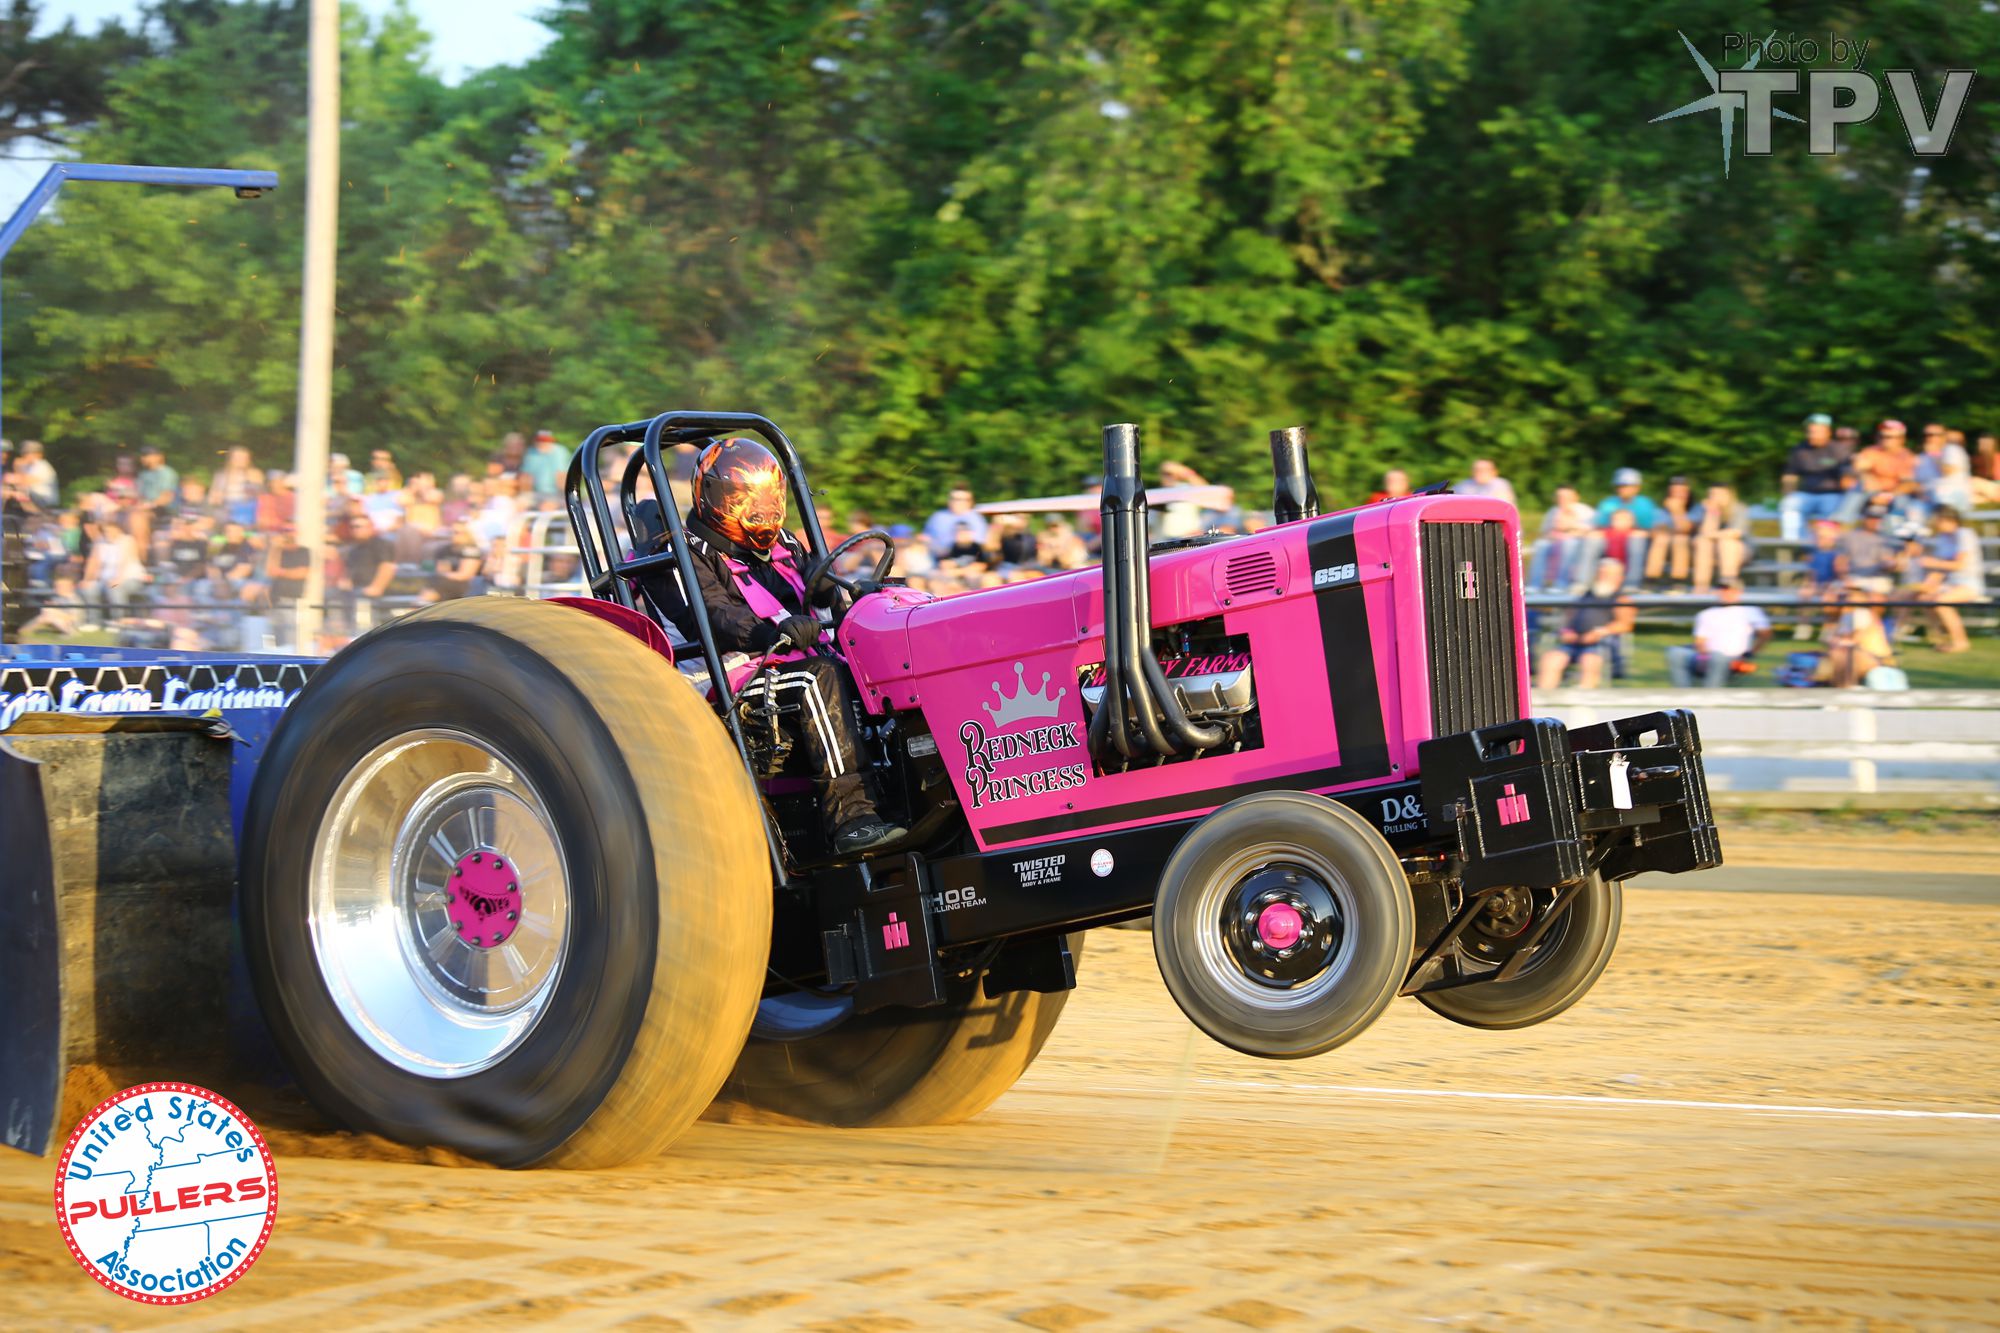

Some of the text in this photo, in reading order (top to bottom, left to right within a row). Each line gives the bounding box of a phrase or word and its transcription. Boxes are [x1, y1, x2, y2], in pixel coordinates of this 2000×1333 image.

[1314, 563, 1356, 585] 656
[959, 720, 1080, 773] REDNECK
[965, 764, 1087, 809] PRINCESS
[1383, 821, 1418, 835] PULLING
[1012, 854, 1066, 873] TWISTED
[1020, 866, 1062, 883] METAL
[960, 897, 987, 909] TEAM
